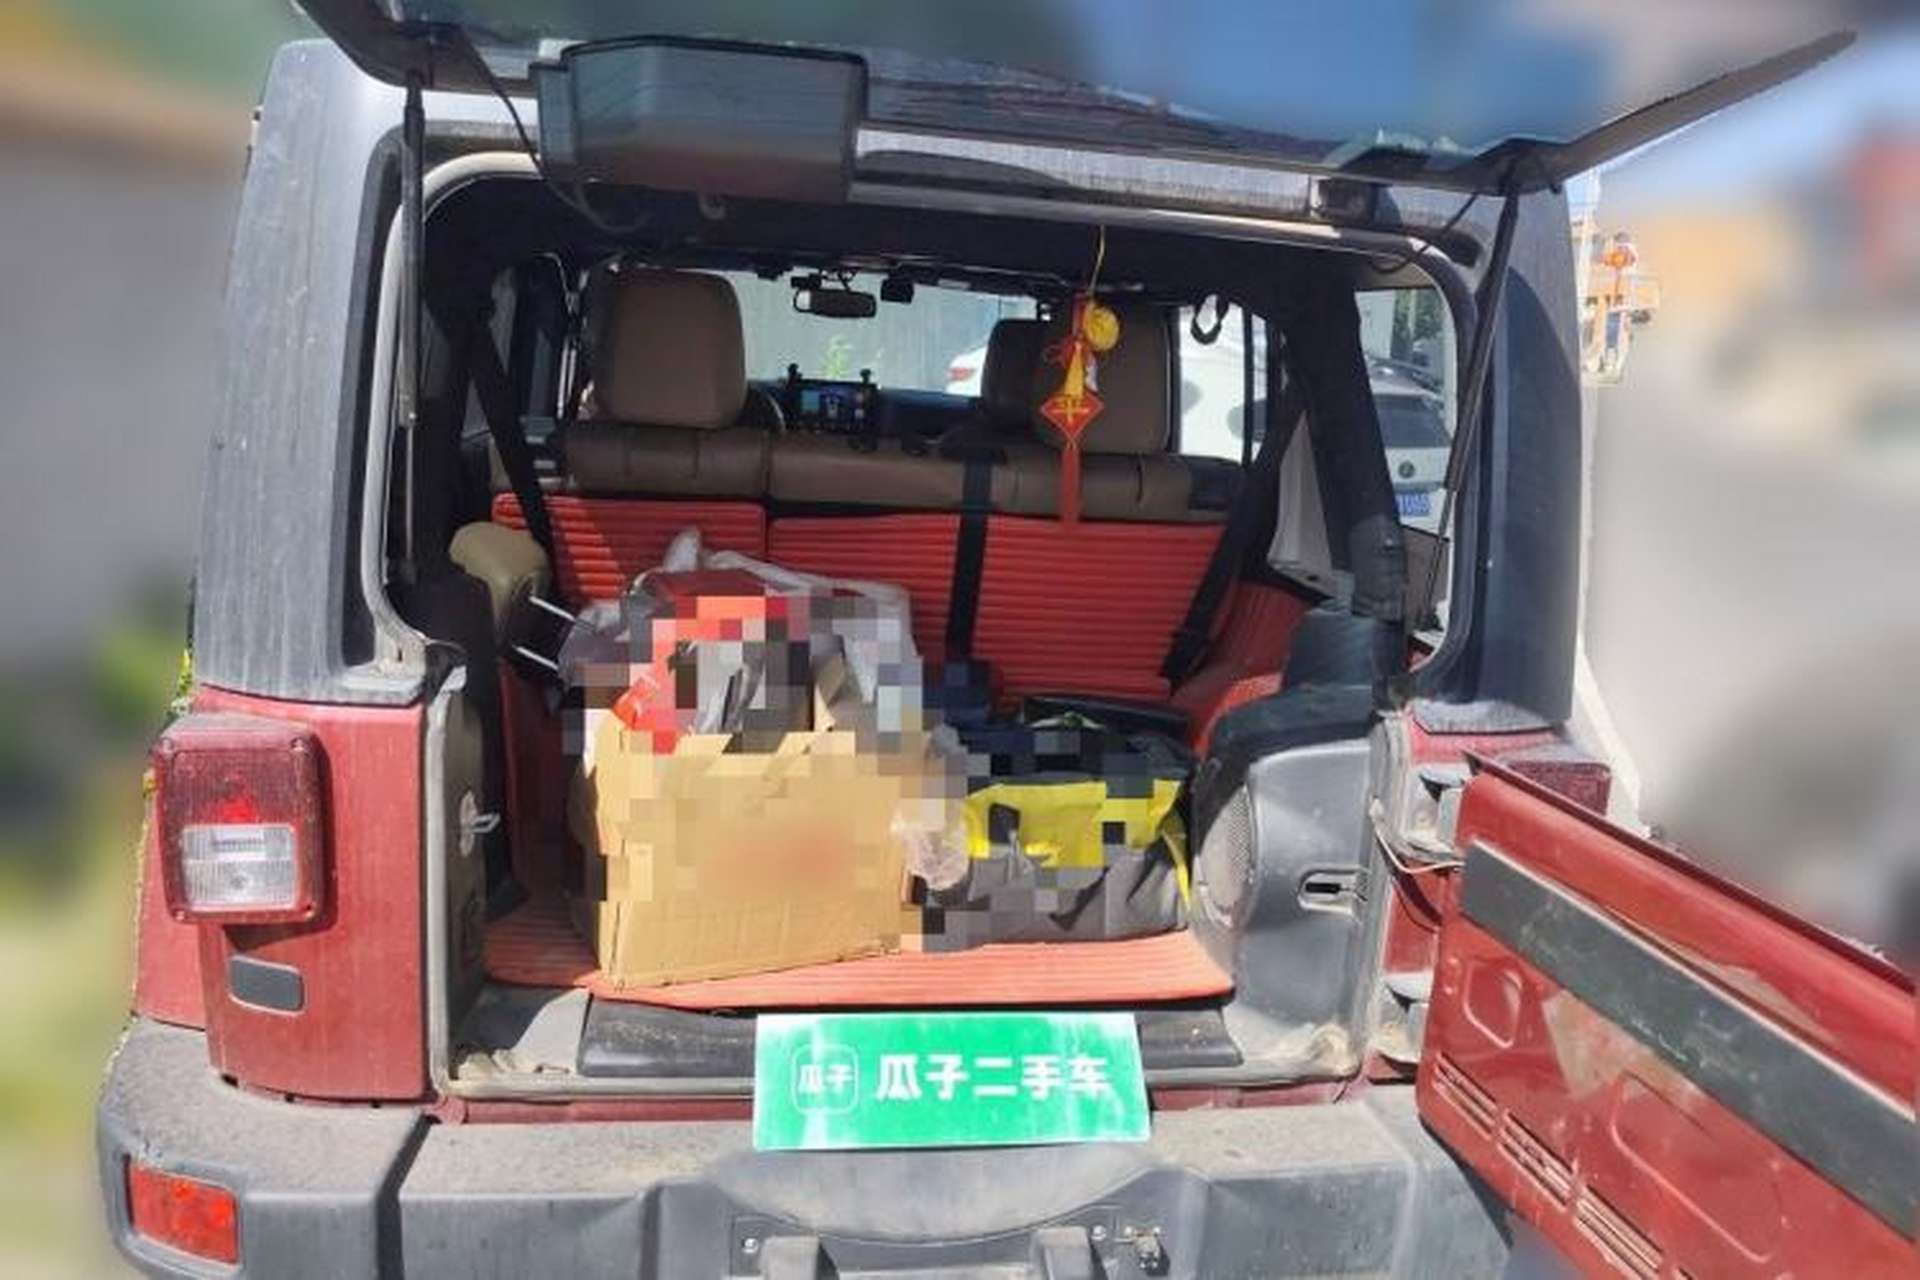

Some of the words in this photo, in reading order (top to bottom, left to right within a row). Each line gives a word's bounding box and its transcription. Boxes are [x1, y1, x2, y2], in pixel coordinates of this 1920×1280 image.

[799, 1064, 853, 1093] 瓜子
[876, 1053, 1109, 1101] 瓜子二手车
